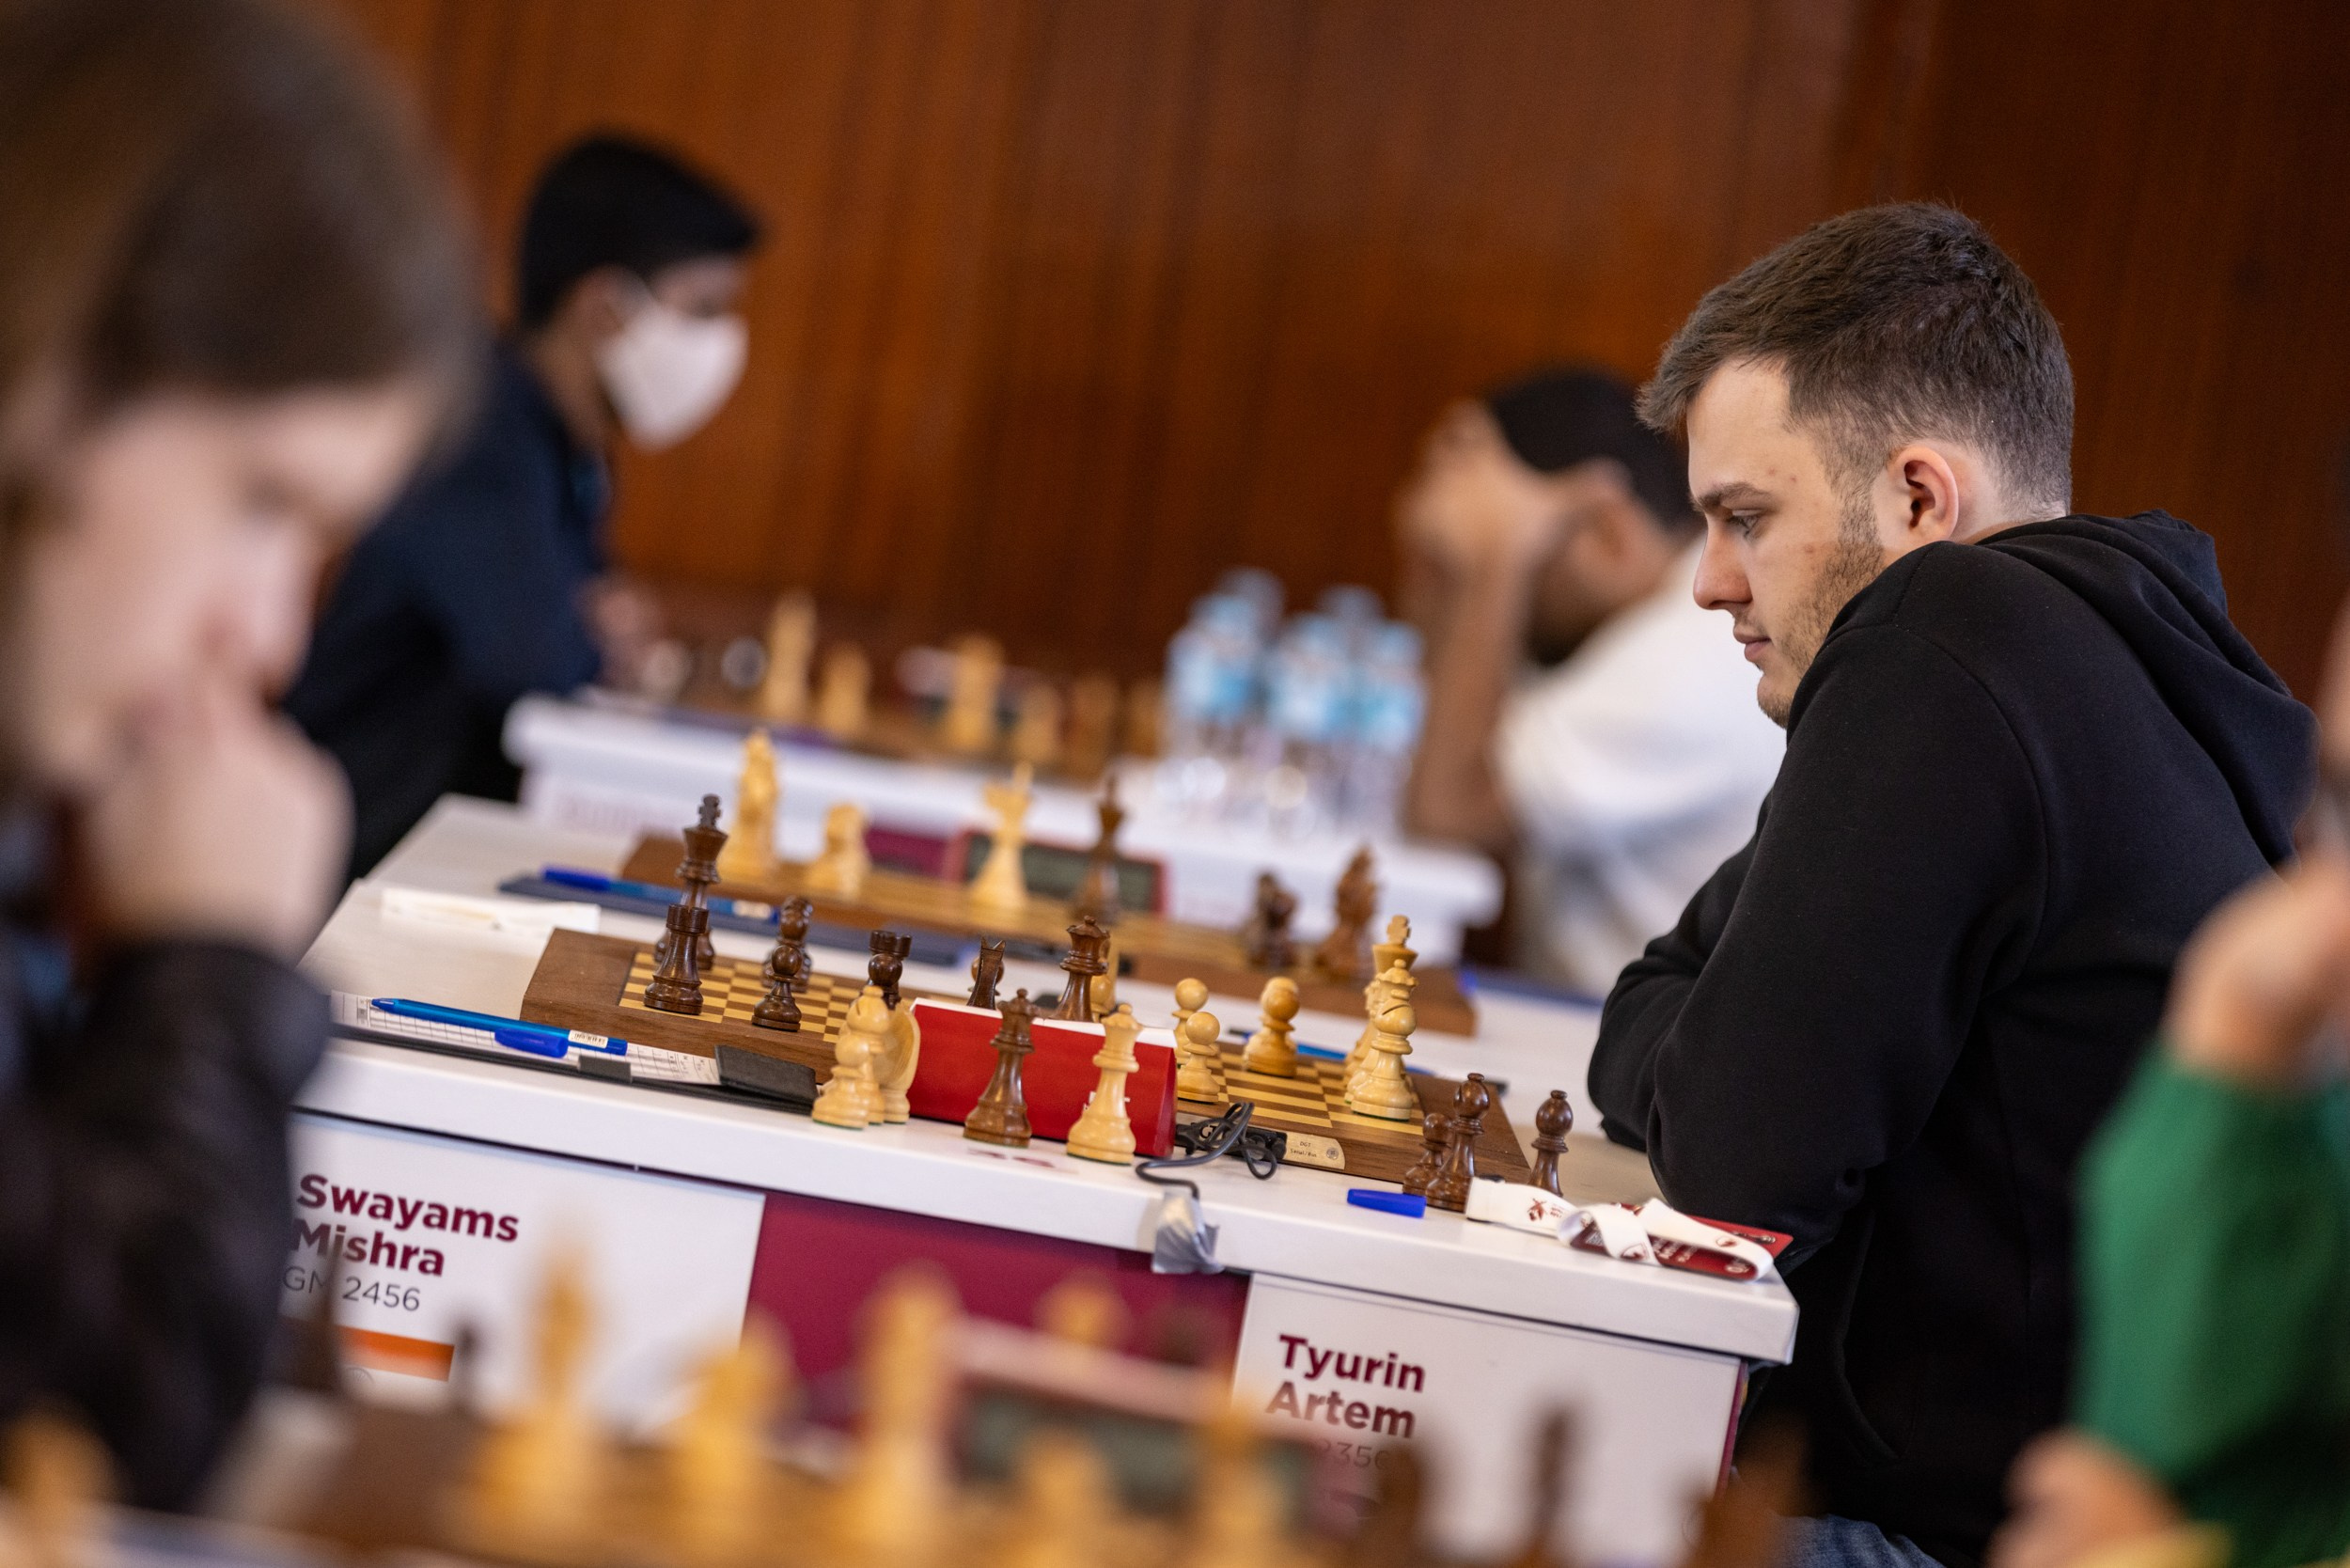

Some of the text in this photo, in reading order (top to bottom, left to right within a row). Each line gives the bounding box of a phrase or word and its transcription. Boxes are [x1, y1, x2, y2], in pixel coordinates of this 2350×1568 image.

[296, 1173, 519, 1243] Swayams
[290, 1218, 445, 1277] Mishra
[342, 1276, 421, 1312] 2456
[1278, 1333, 1427, 1393] Tyurin
[1264, 1380, 1416, 1439] Artem
